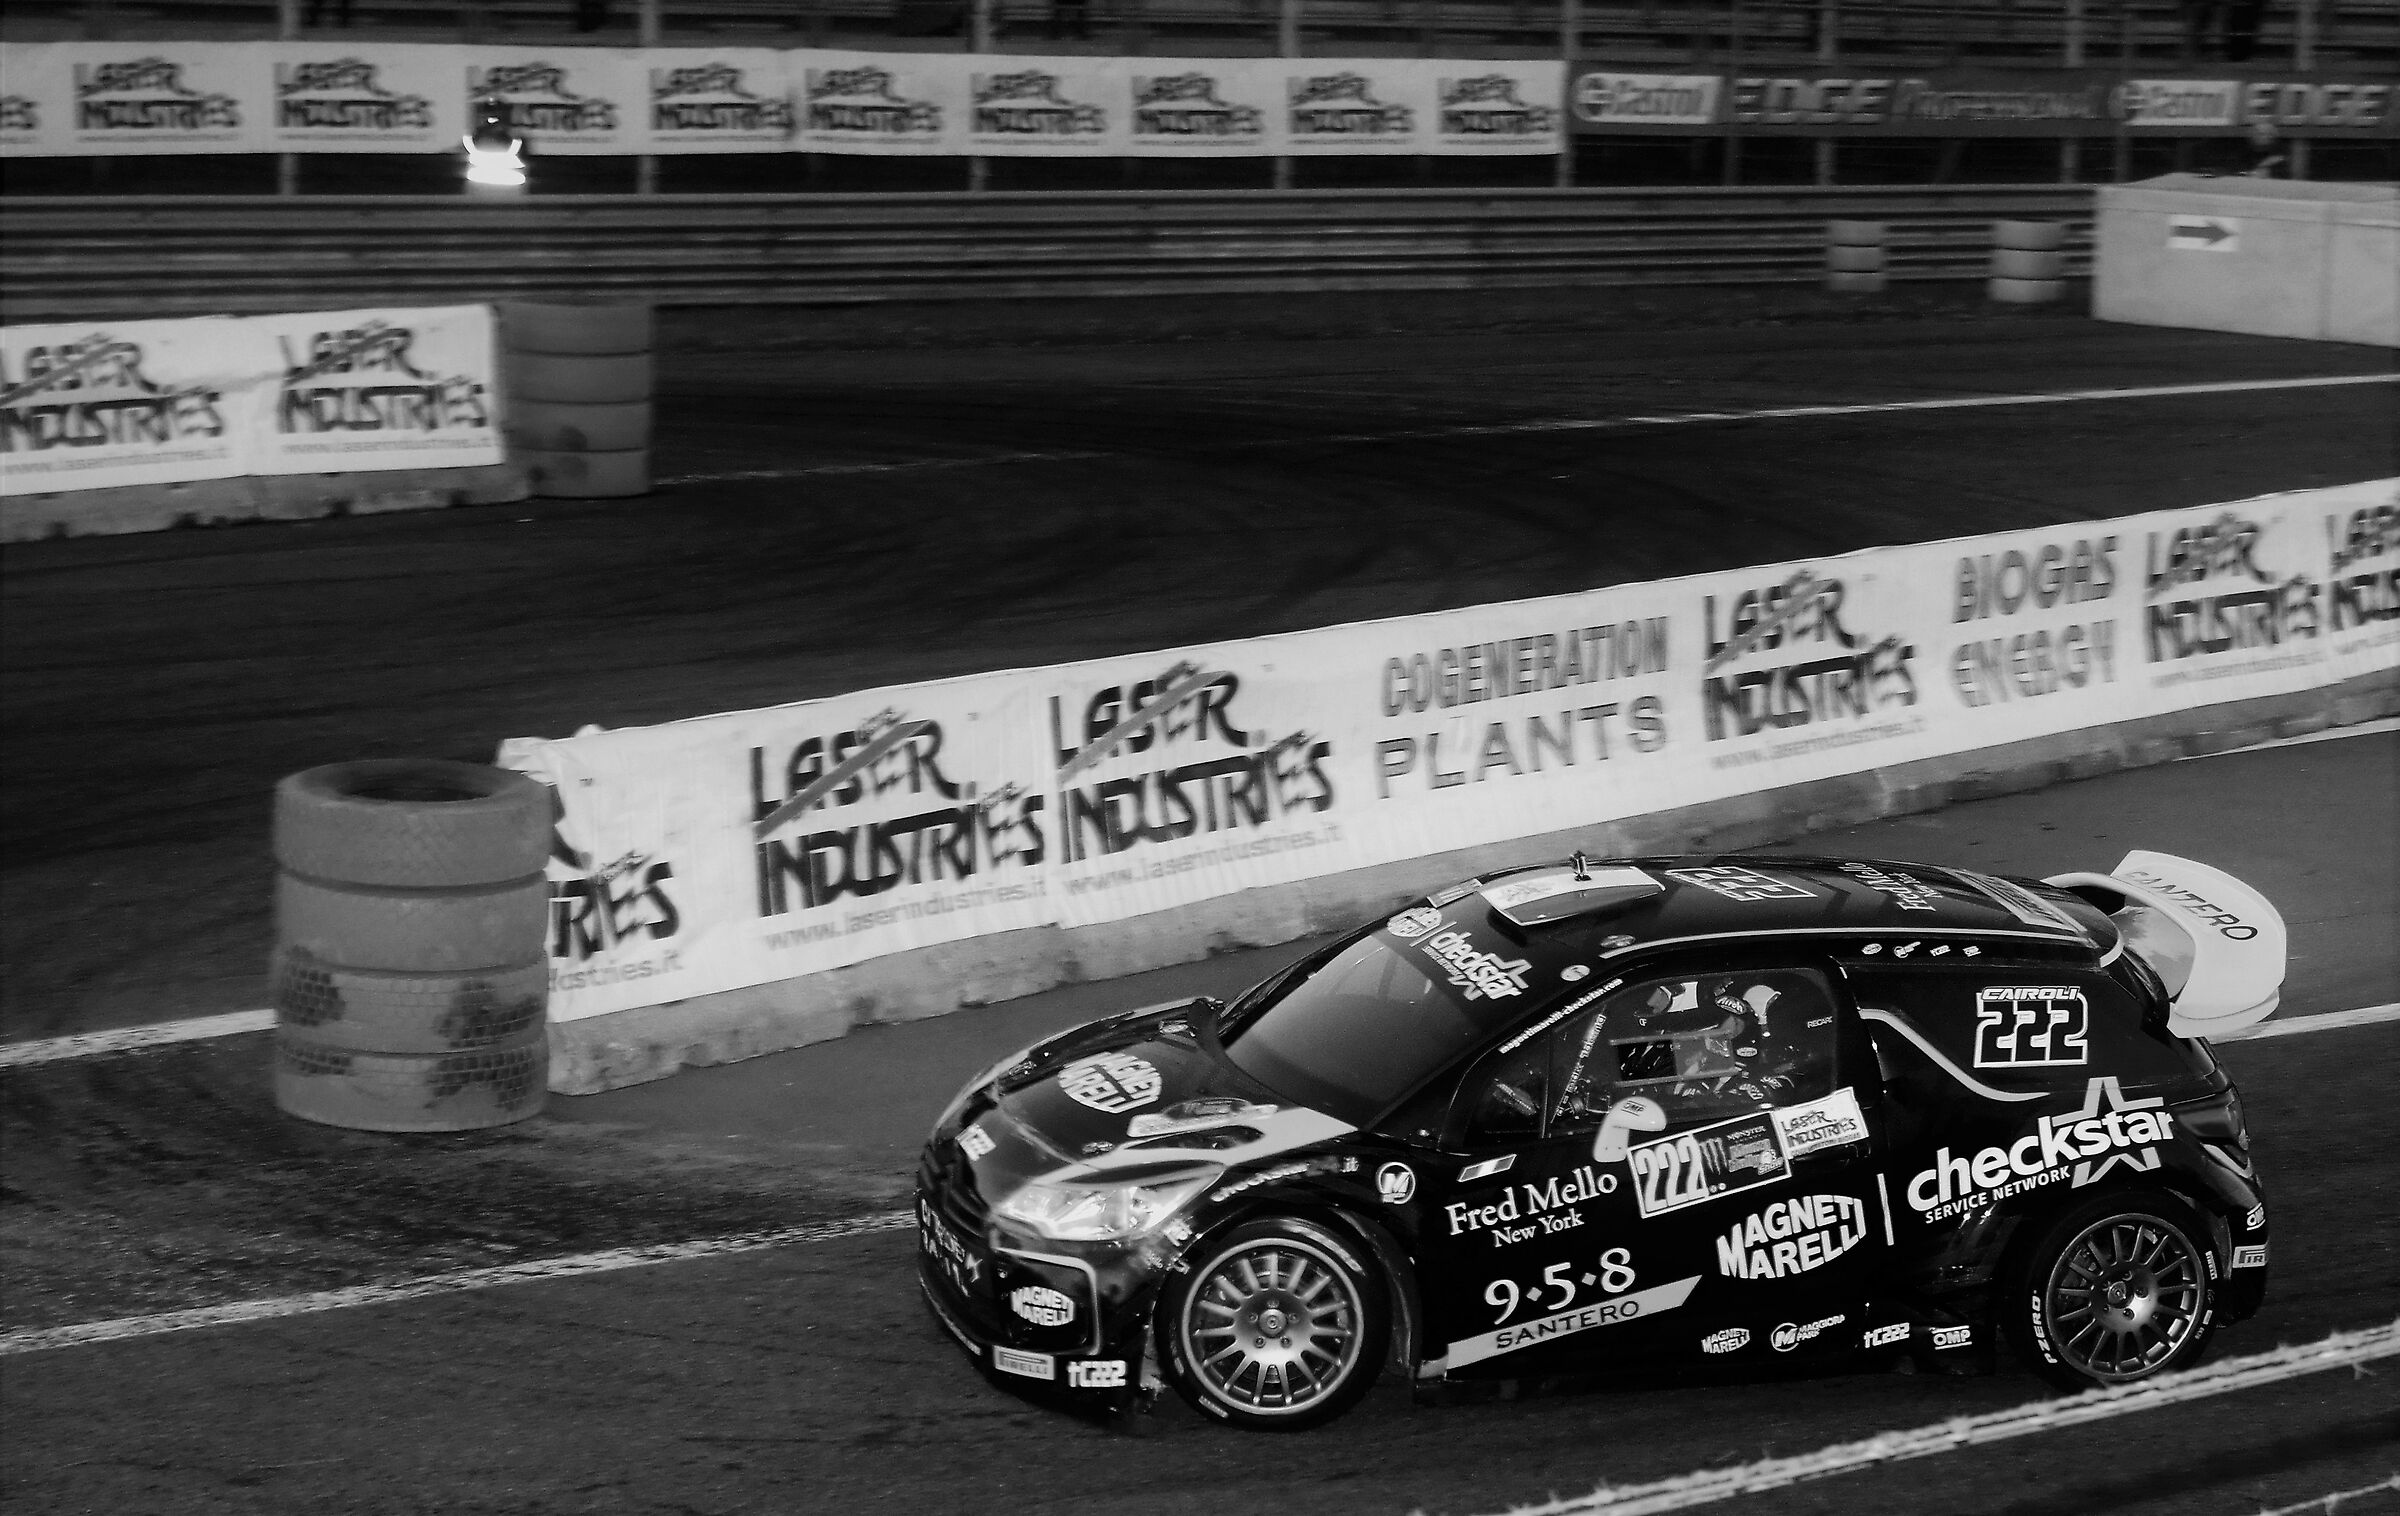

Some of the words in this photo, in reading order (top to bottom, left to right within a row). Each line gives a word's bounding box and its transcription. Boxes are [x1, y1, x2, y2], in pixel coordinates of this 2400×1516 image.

[278, 319, 424, 388] LASER
[1953, 535, 2117, 624] BIOGAS
[2145, 513, 2275, 600] LASER
[1703, 569, 1857, 674] LASER
[2144, 574, 2320, 664] INDUSTRIES
[1381, 616, 1670, 718] COGENERATION
[1702, 635, 1917, 742] INDUSTRIES
[1951, 619, 2117, 708] ENERGY
[1050, 660, 1249, 783] LASER
[1376, 695, 1666, 799] PLANTS
[751, 706, 962, 840] LASER
[1060, 729, 1334, 864] INDUSTRIES
[756, 781, 1045, 918] INDUSTRIES
[1974, 991, 2089, 1068] 222
[1981, 986, 2080, 1001] CAIROLI
[1781, 1110, 1834, 1133] LASER
[1787, 1117, 1857, 1149] INDUSTRIES
[1907, 1111, 2174, 1211] checkstar
[1444, 1187, 1518, 1235] Fred
[1523, 1166, 1618, 1214] Mello
[1634, 1135, 1709, 1213] 222
[1924, 1192, 1988, 1224] SERVICE
[1992, 1166, 2071, 1201] NETWORK
[1492, 1223, 1537, 1248] New
[1539, 1208, 1584, 1236] York
[1717, 1195, 1866, 1262] MAGNETI
[1496, 1301, 1640, 1348] SANTERO
